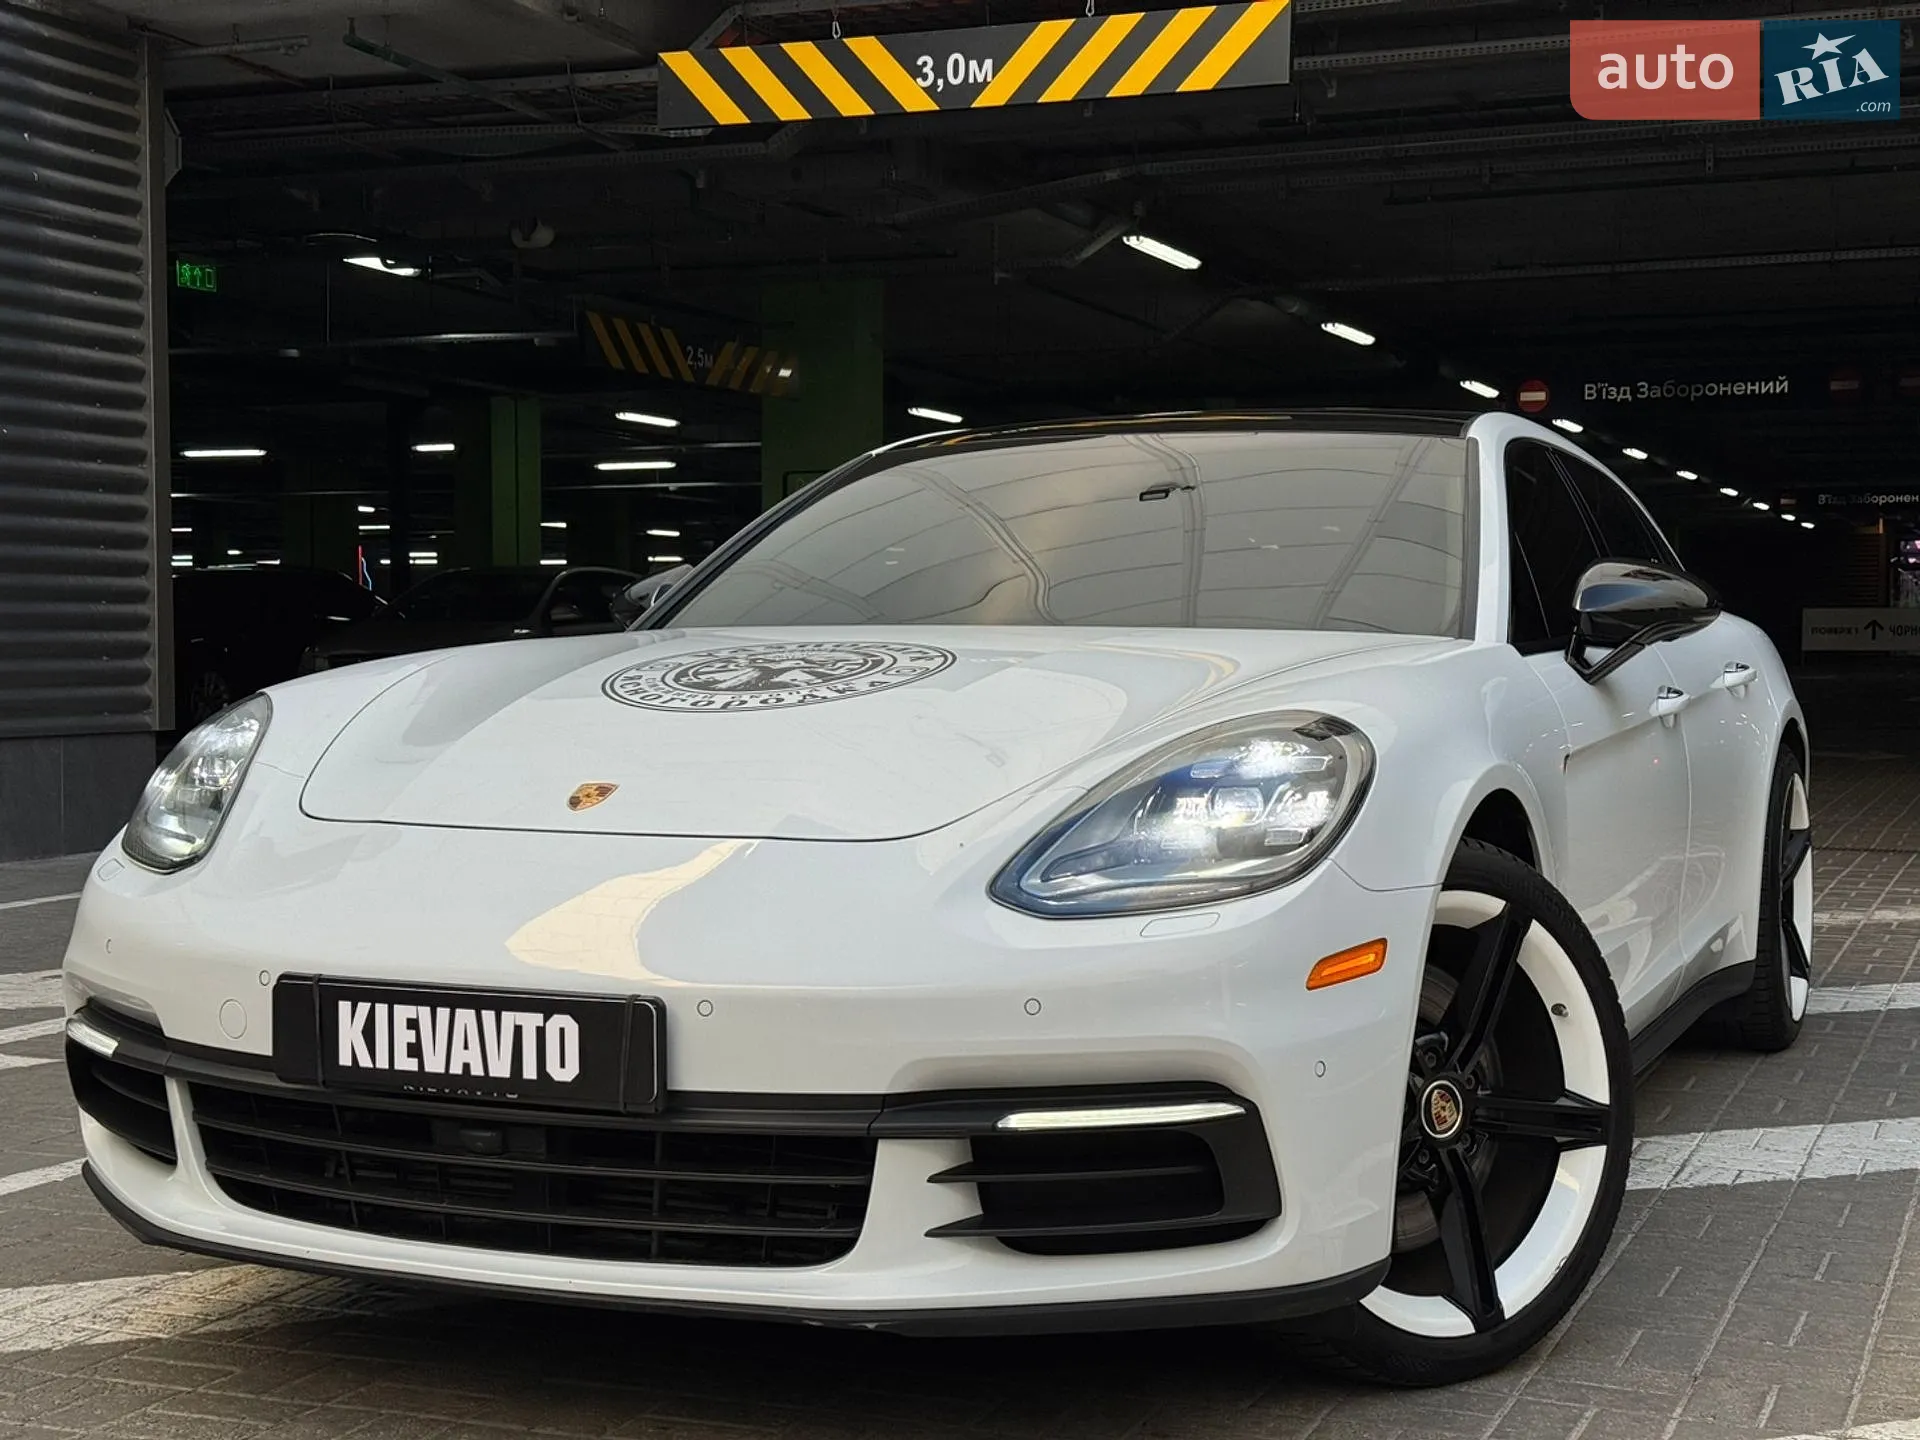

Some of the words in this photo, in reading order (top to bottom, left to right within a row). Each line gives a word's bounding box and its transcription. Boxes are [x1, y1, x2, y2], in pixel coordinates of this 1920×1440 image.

[1636, 375, 1789, 401] Заборонений
[1888, 624, 1920, 637] ЧОРН
[338, 1000, 580, 1083] KIEVAVTO
